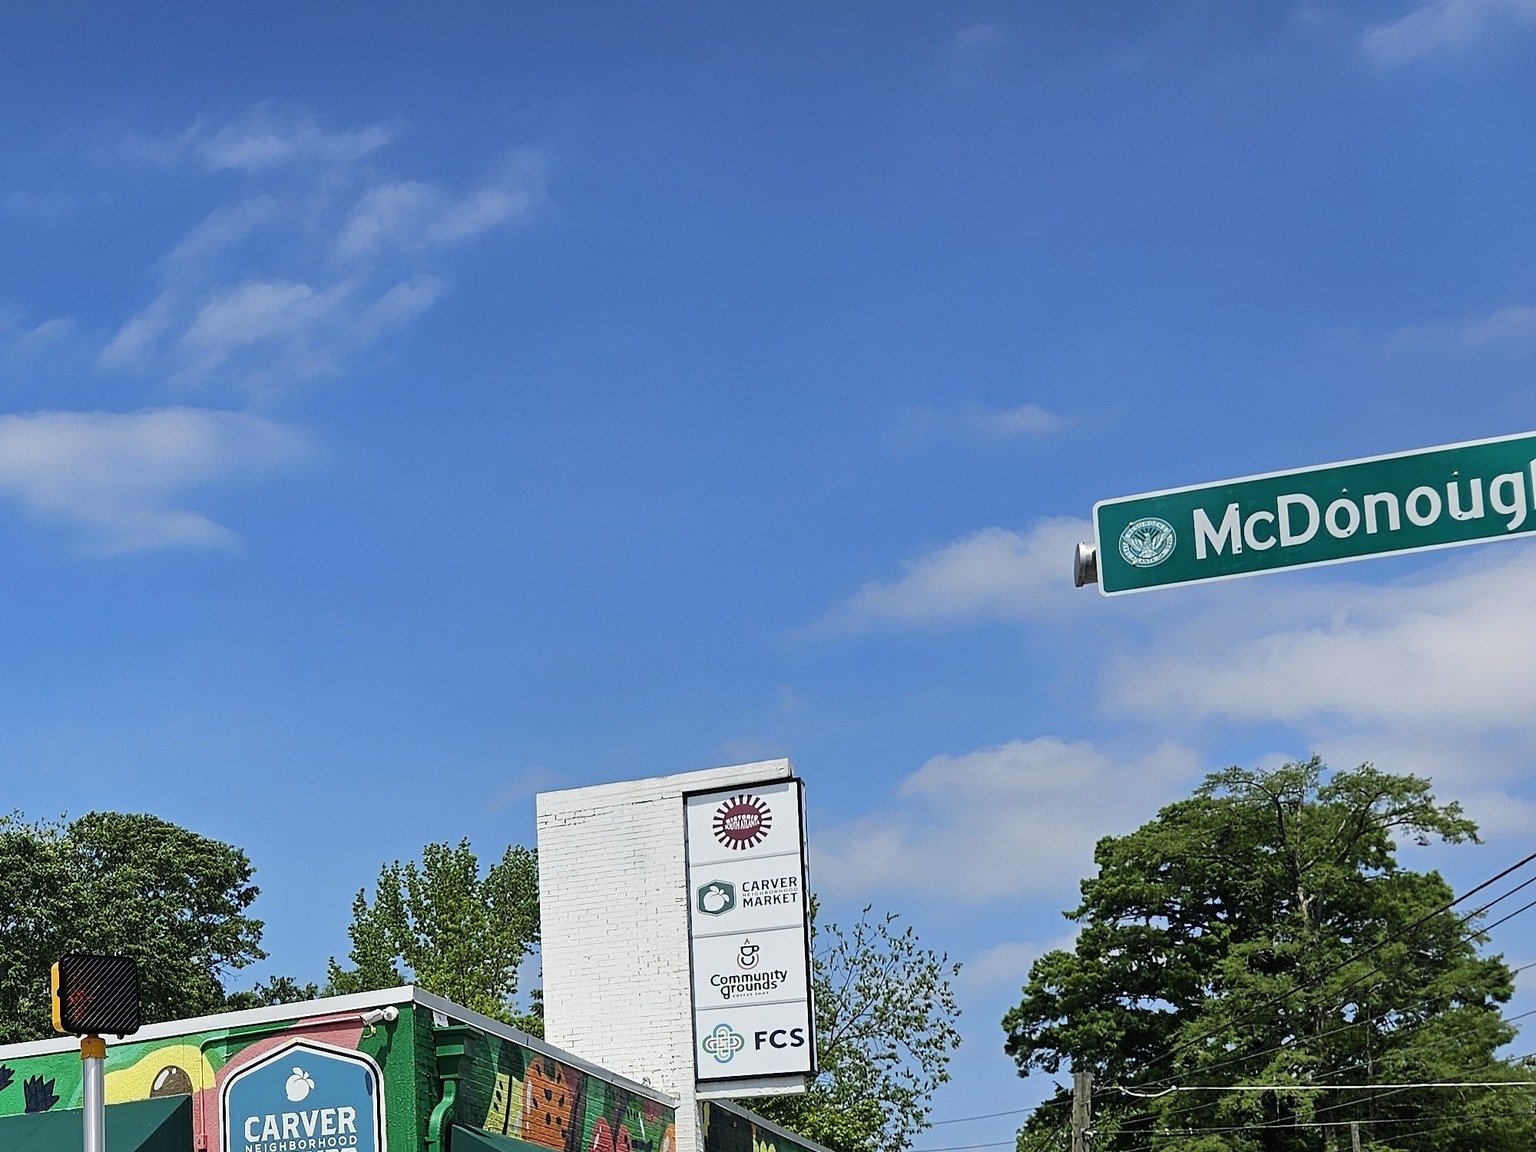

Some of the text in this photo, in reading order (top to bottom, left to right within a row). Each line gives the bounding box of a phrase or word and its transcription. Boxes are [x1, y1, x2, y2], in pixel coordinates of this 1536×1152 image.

[1193, 458, 1536, 560] McDonoug
[743, 877, 797, 892] CARVER
[743, 887, 798, 896] NEIGHBORHOOD
[744, 893, 797, 908] MARKET
[711, 970, 787, 986] Community
[721, 981, 778, 999] grounds
[755, 1028, 804, 1050] FCS
[244, 1106, 357, 1142] CARVER
